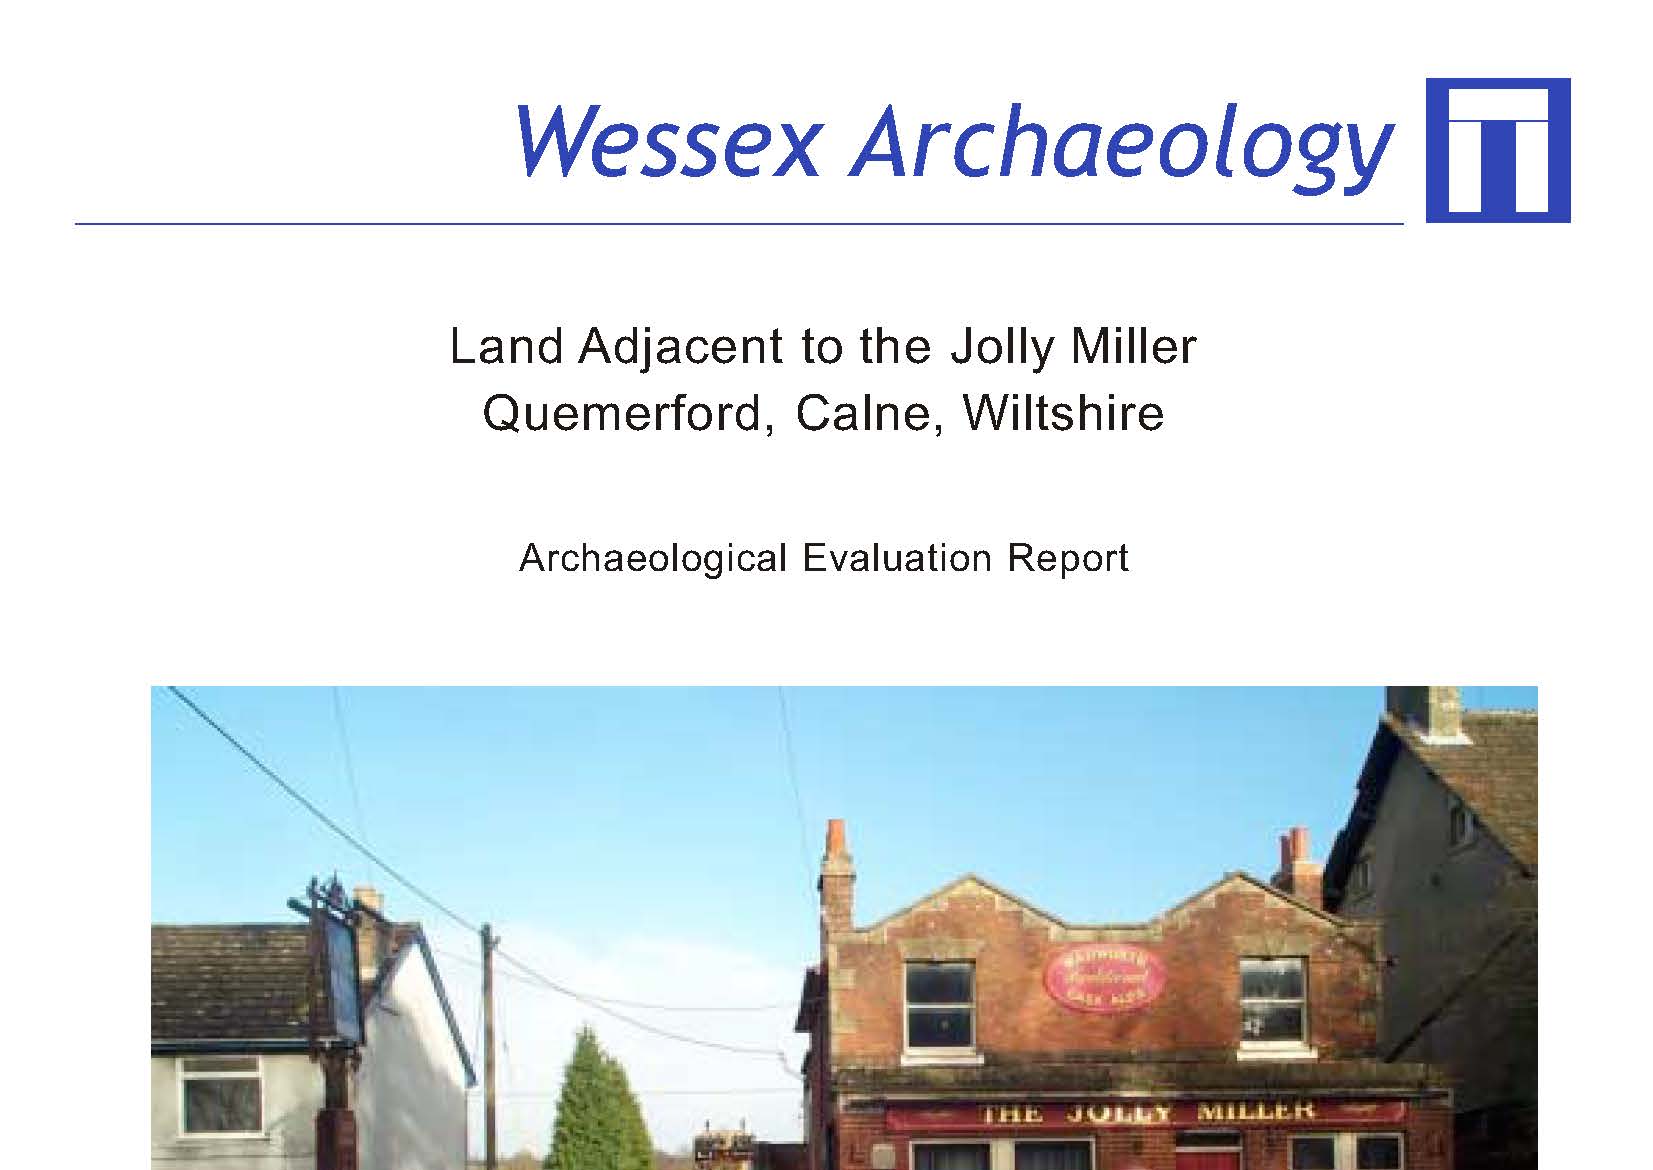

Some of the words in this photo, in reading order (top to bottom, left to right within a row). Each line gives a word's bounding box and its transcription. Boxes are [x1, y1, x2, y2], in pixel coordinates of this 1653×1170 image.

[518, 105, 825, 177] Wessex
[847, 103, 1396, 196] Archaeology
[453, 327, 561, 364] Land
[578, 327, 783, 374] Adjacent
[802, 328, 842, 364] to
[860, 327, 930, 364] the
[951, 327, 1055, 374] Jolly
[1074, 327, 1197, 364] Miller
[484, 394, 773, 437] Quemerford,
[798, 394, 942, 437] Calne,
[963, 394, 1163, 431] Wiltshire
[519, 543, 785, 579] Archaeological
[805, 543, 990, 572] Evaluation
[1010, 543, 1129, 579] Report
[984, 1104, 1043, 1124] THE
[1067, 1102, 1173, 1124] JOLLY
[1197, 1100, 1317, 1122] MILLER
